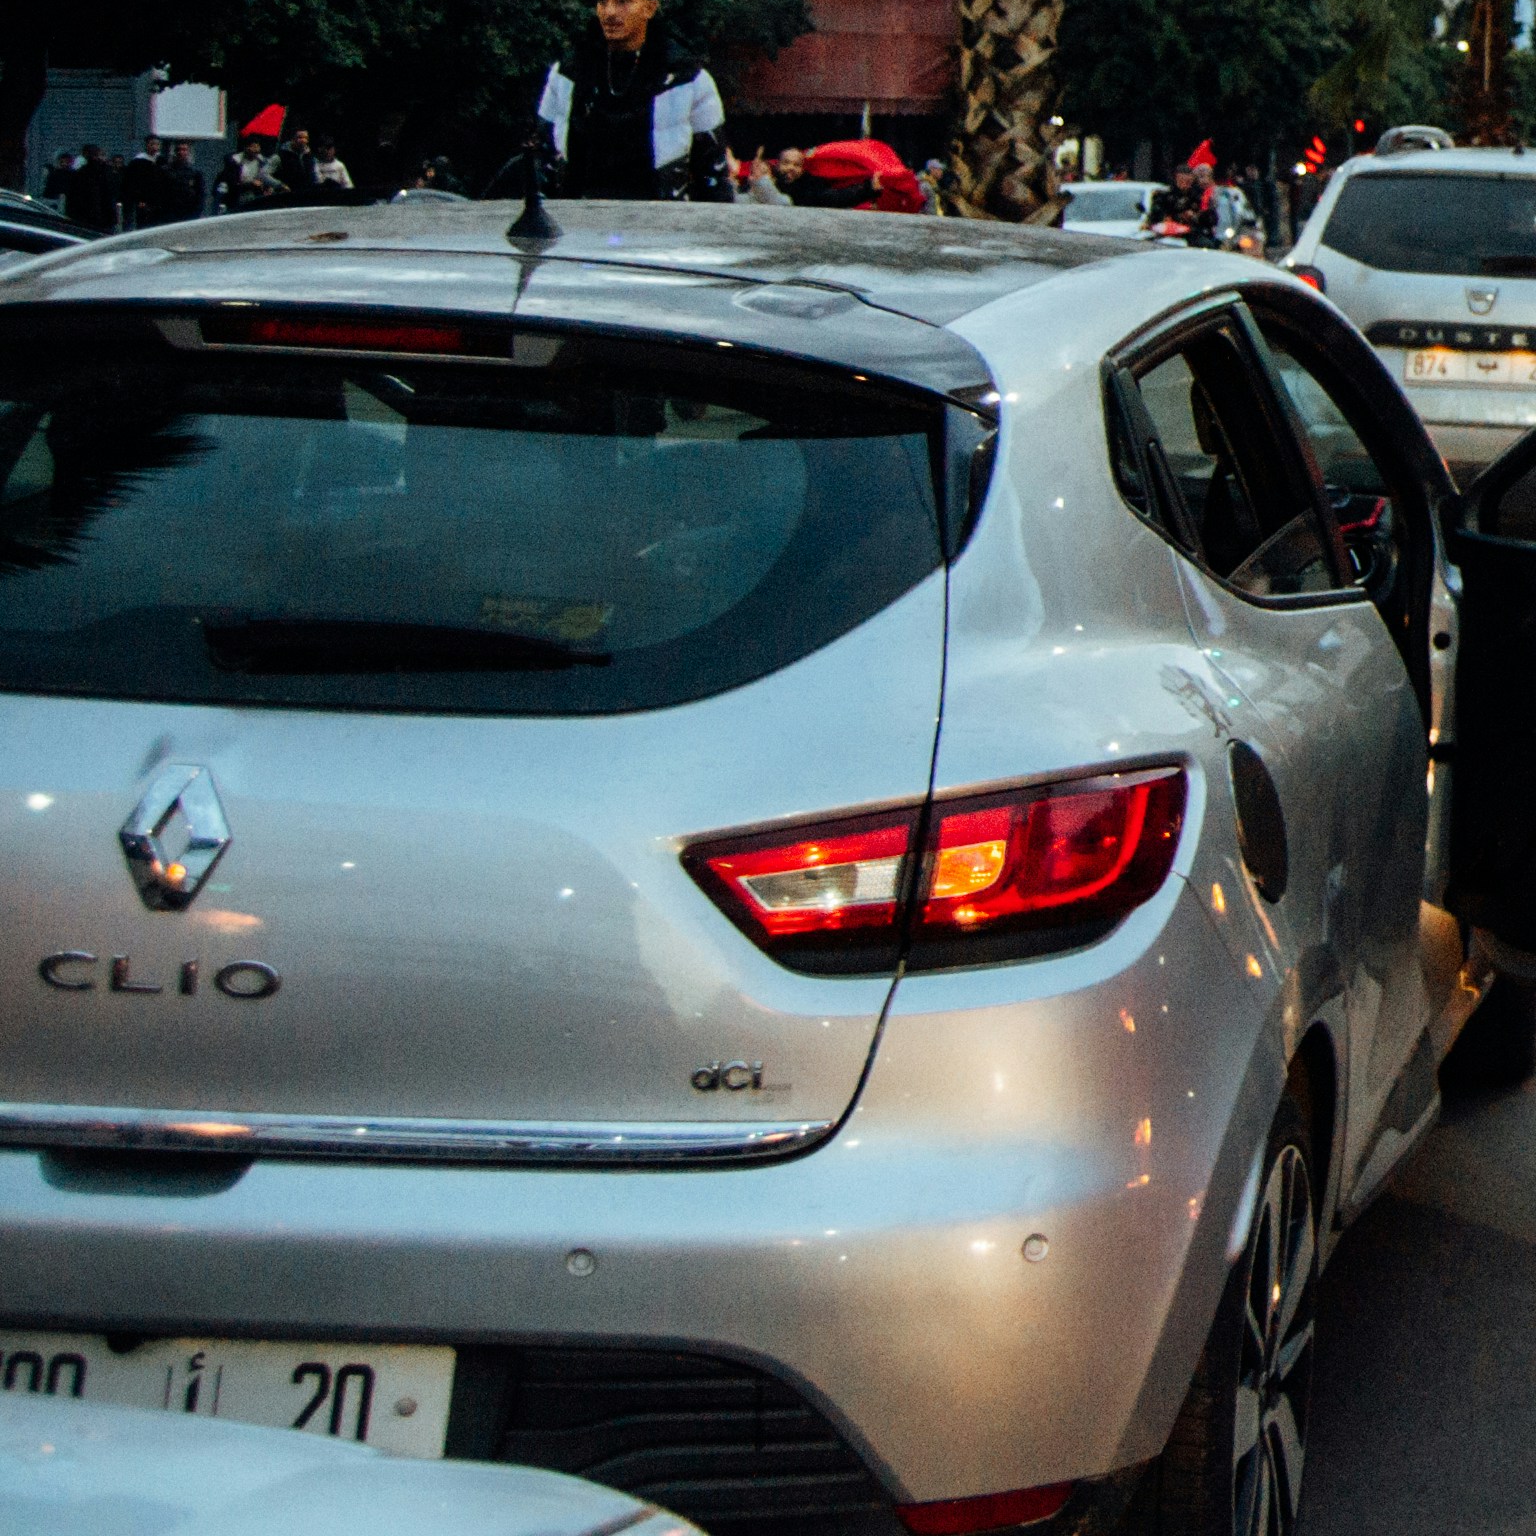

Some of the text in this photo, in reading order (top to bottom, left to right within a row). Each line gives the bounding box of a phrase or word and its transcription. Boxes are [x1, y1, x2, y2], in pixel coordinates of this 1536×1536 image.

[1413, 351, 1447, 377] 874
[38, 950, 283, 1000] CLIO
[290, 1361, 376, 1441] 20
